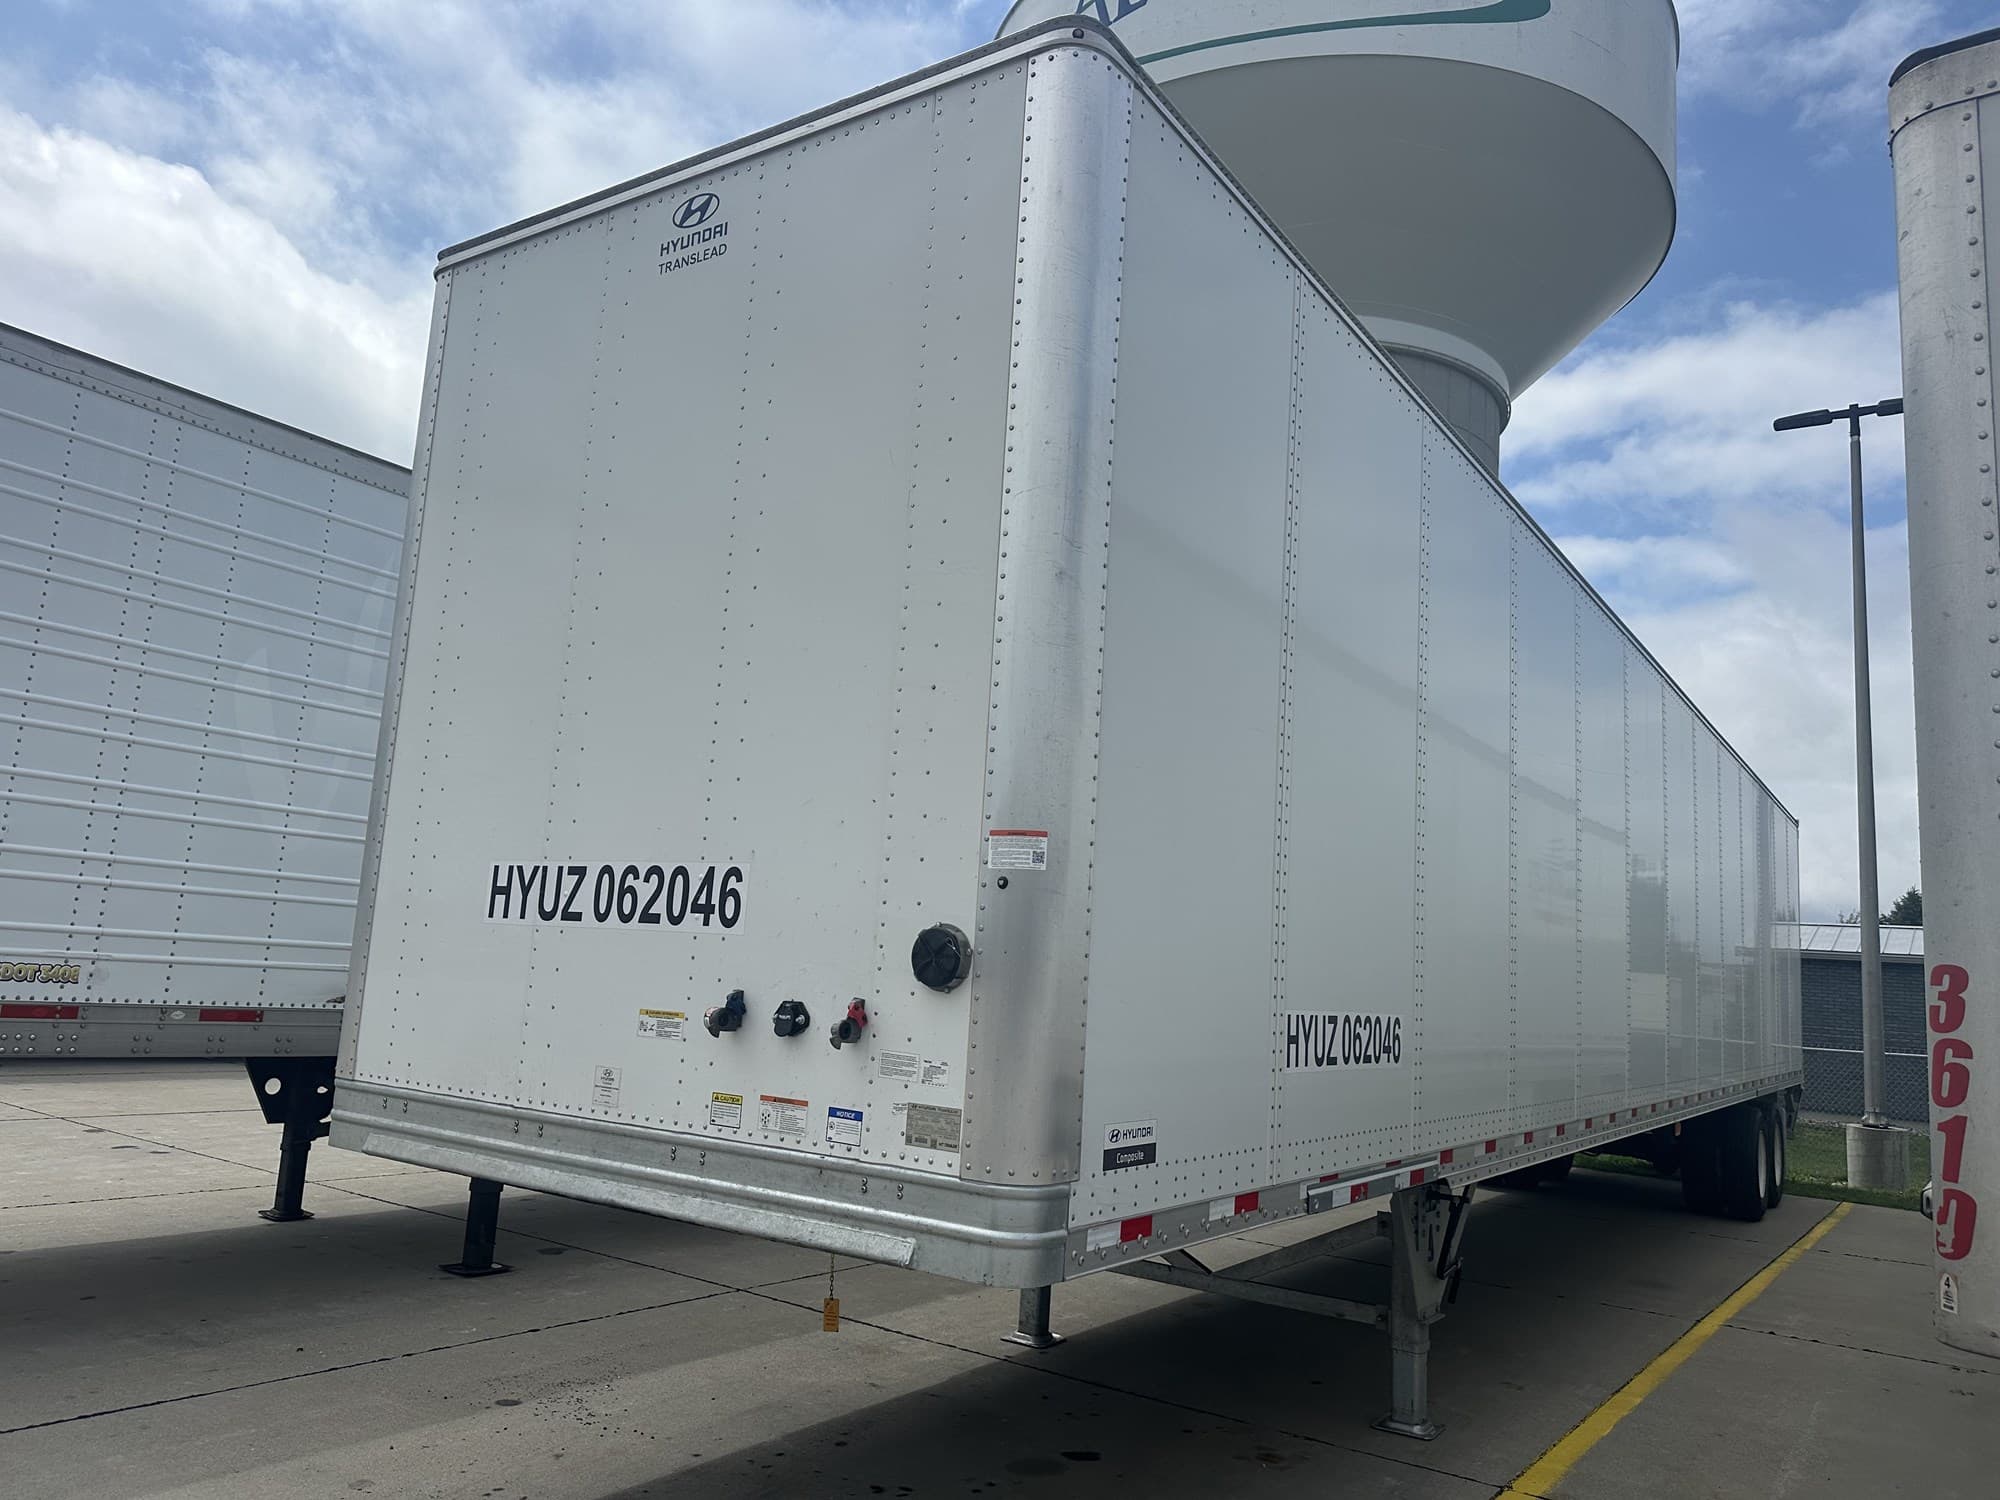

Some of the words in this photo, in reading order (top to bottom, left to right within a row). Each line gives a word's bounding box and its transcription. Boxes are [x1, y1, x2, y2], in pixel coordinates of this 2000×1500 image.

[660, 222, 728, 256] HYUNDAI
[658, 243, 728, 274] TRANSLEAD
[488, 865, 587, 921] HYUZ
[593, 865, 743, 928] 062046
[0, 962, 39, 982] DOT
[1286, 1014, 1338, 1068] HYUZ
[1342, 1014, 1401, 1065] 062046
[1122, 1126, 1153, 1140] HYUNDAI
[1116, 1151, 1144, 1164] Composite
